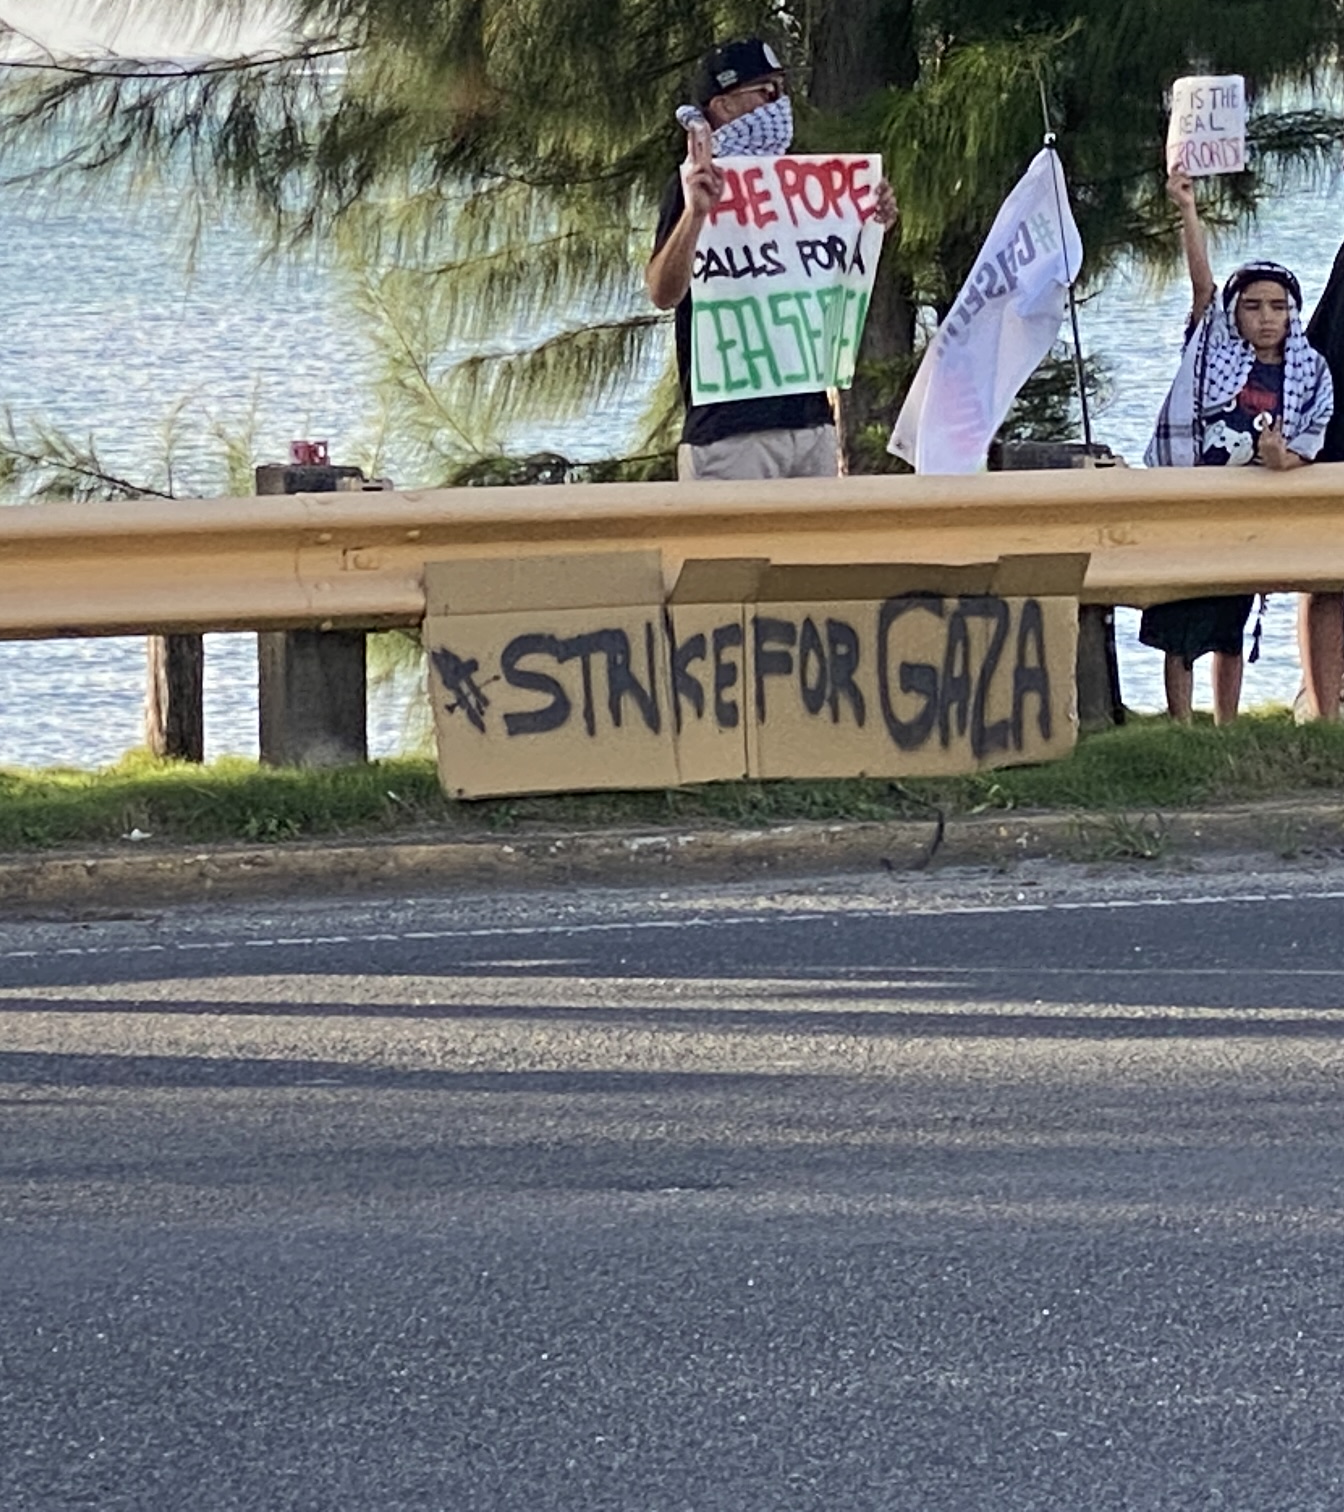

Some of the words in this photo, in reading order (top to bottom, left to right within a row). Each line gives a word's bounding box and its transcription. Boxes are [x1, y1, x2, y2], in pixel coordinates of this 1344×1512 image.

[1209, 84, 1239, 110] THE
[708, 167, 779, 229] HE
[774, 159, 876, 228] POPE
[693, 240, 786, 283] CALLS
[796, 234, 847, 277] FOR
